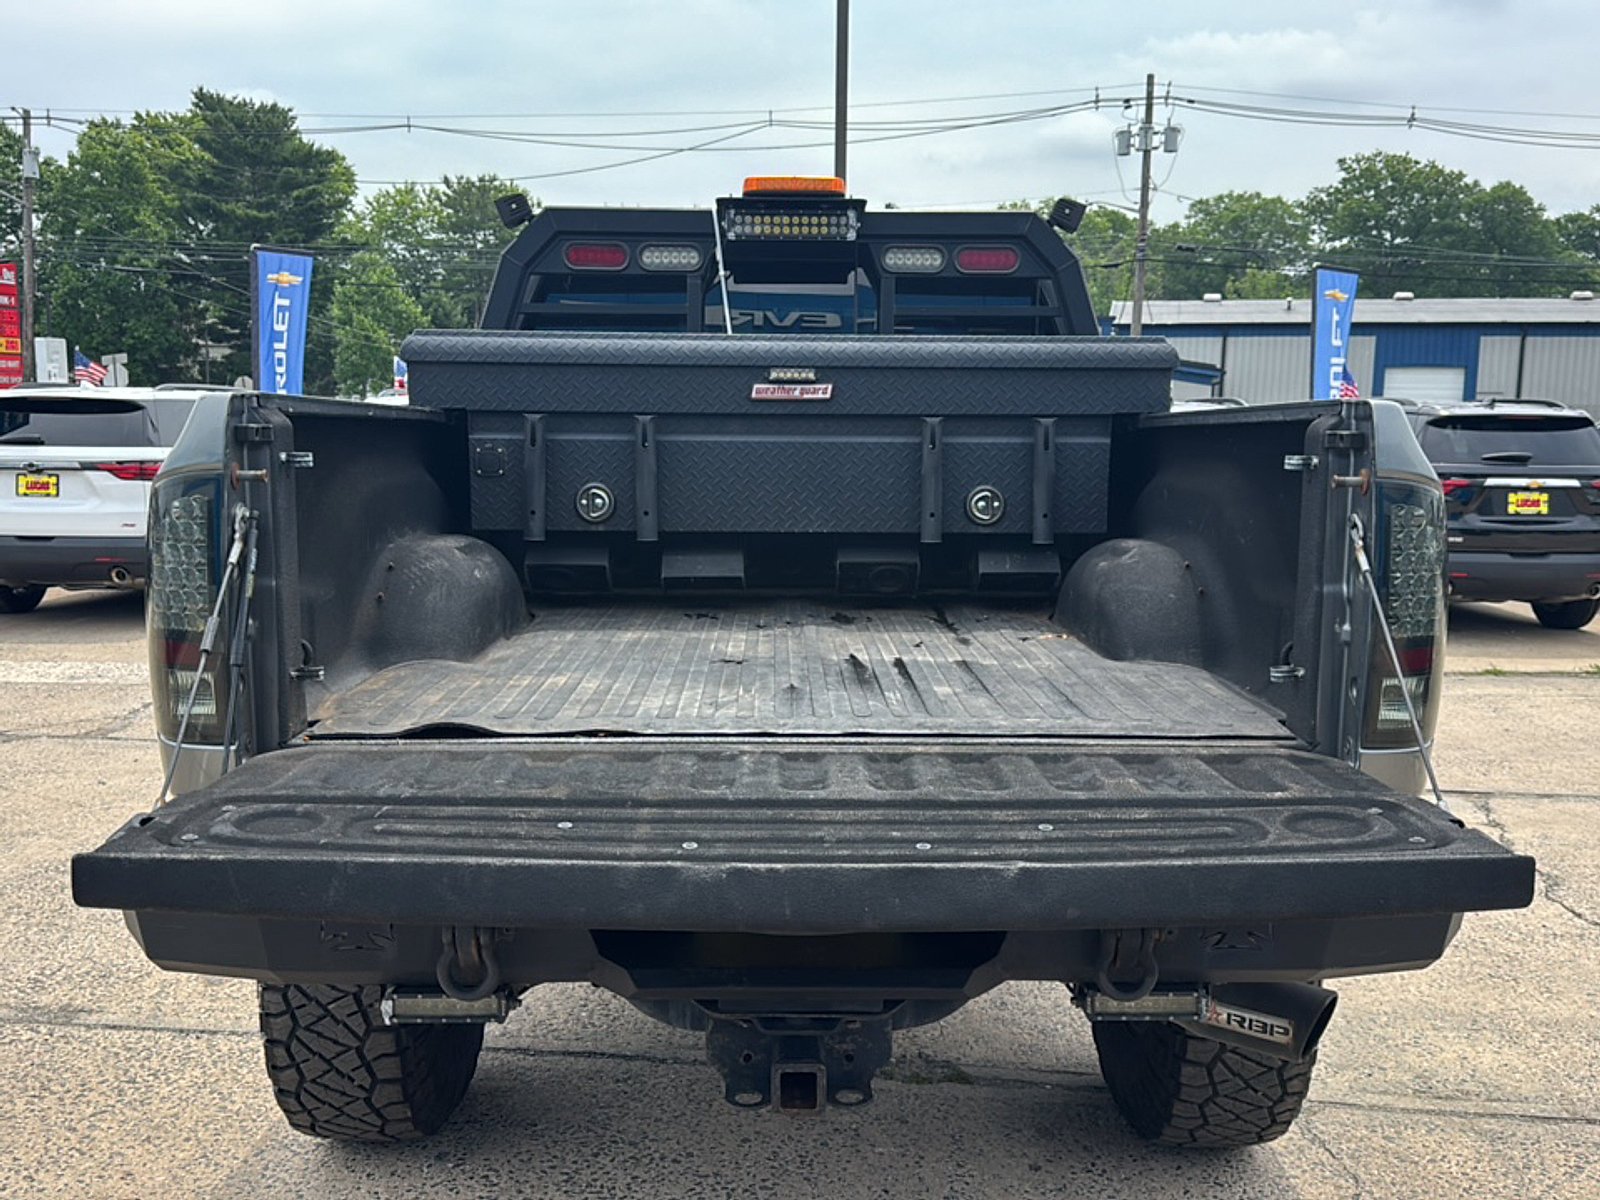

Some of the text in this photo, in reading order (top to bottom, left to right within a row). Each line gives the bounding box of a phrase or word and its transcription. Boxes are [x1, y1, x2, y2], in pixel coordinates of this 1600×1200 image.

[755, 385, 829, 397] weather guard
[1226, 1012, 1290, 1036] RBP
